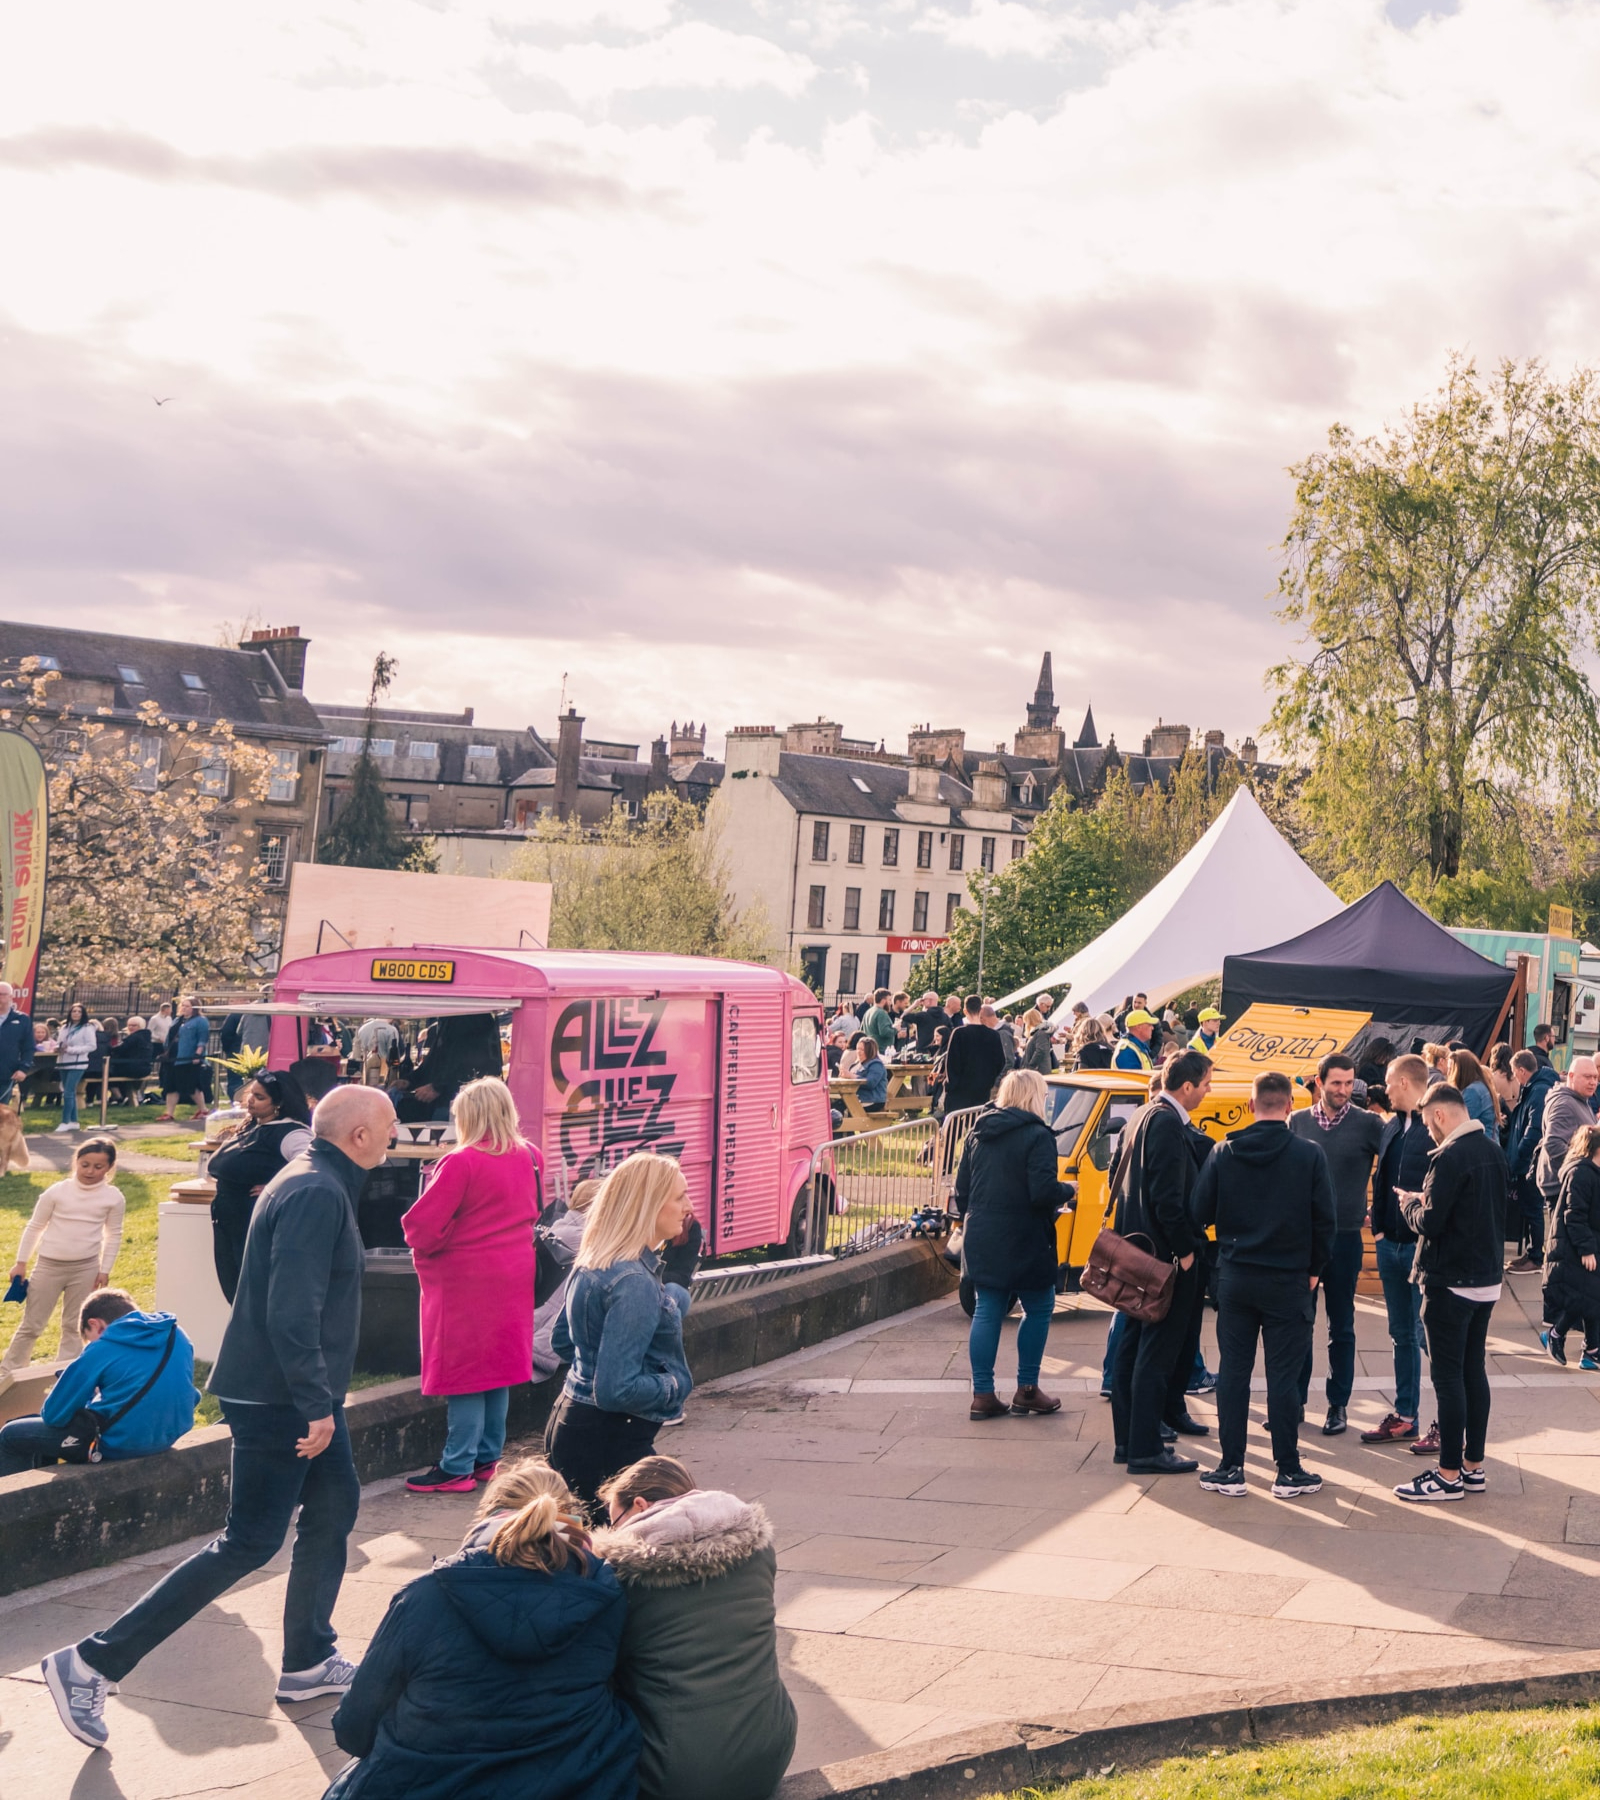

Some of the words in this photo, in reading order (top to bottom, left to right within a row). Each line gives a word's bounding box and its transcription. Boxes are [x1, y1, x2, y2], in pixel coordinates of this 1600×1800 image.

[14, 809, 33, 888] SHACK
[11, 896, 30, 950] RUM
[379, 963, 415, 977] W800
[419, 964, 446, 978] CDS
[551, 1000, 668, 1094] ALLEZ
[726, 1005, 740, 1115] CAFFEINE
[722, 1123, 737, 1238] PEDALERS
